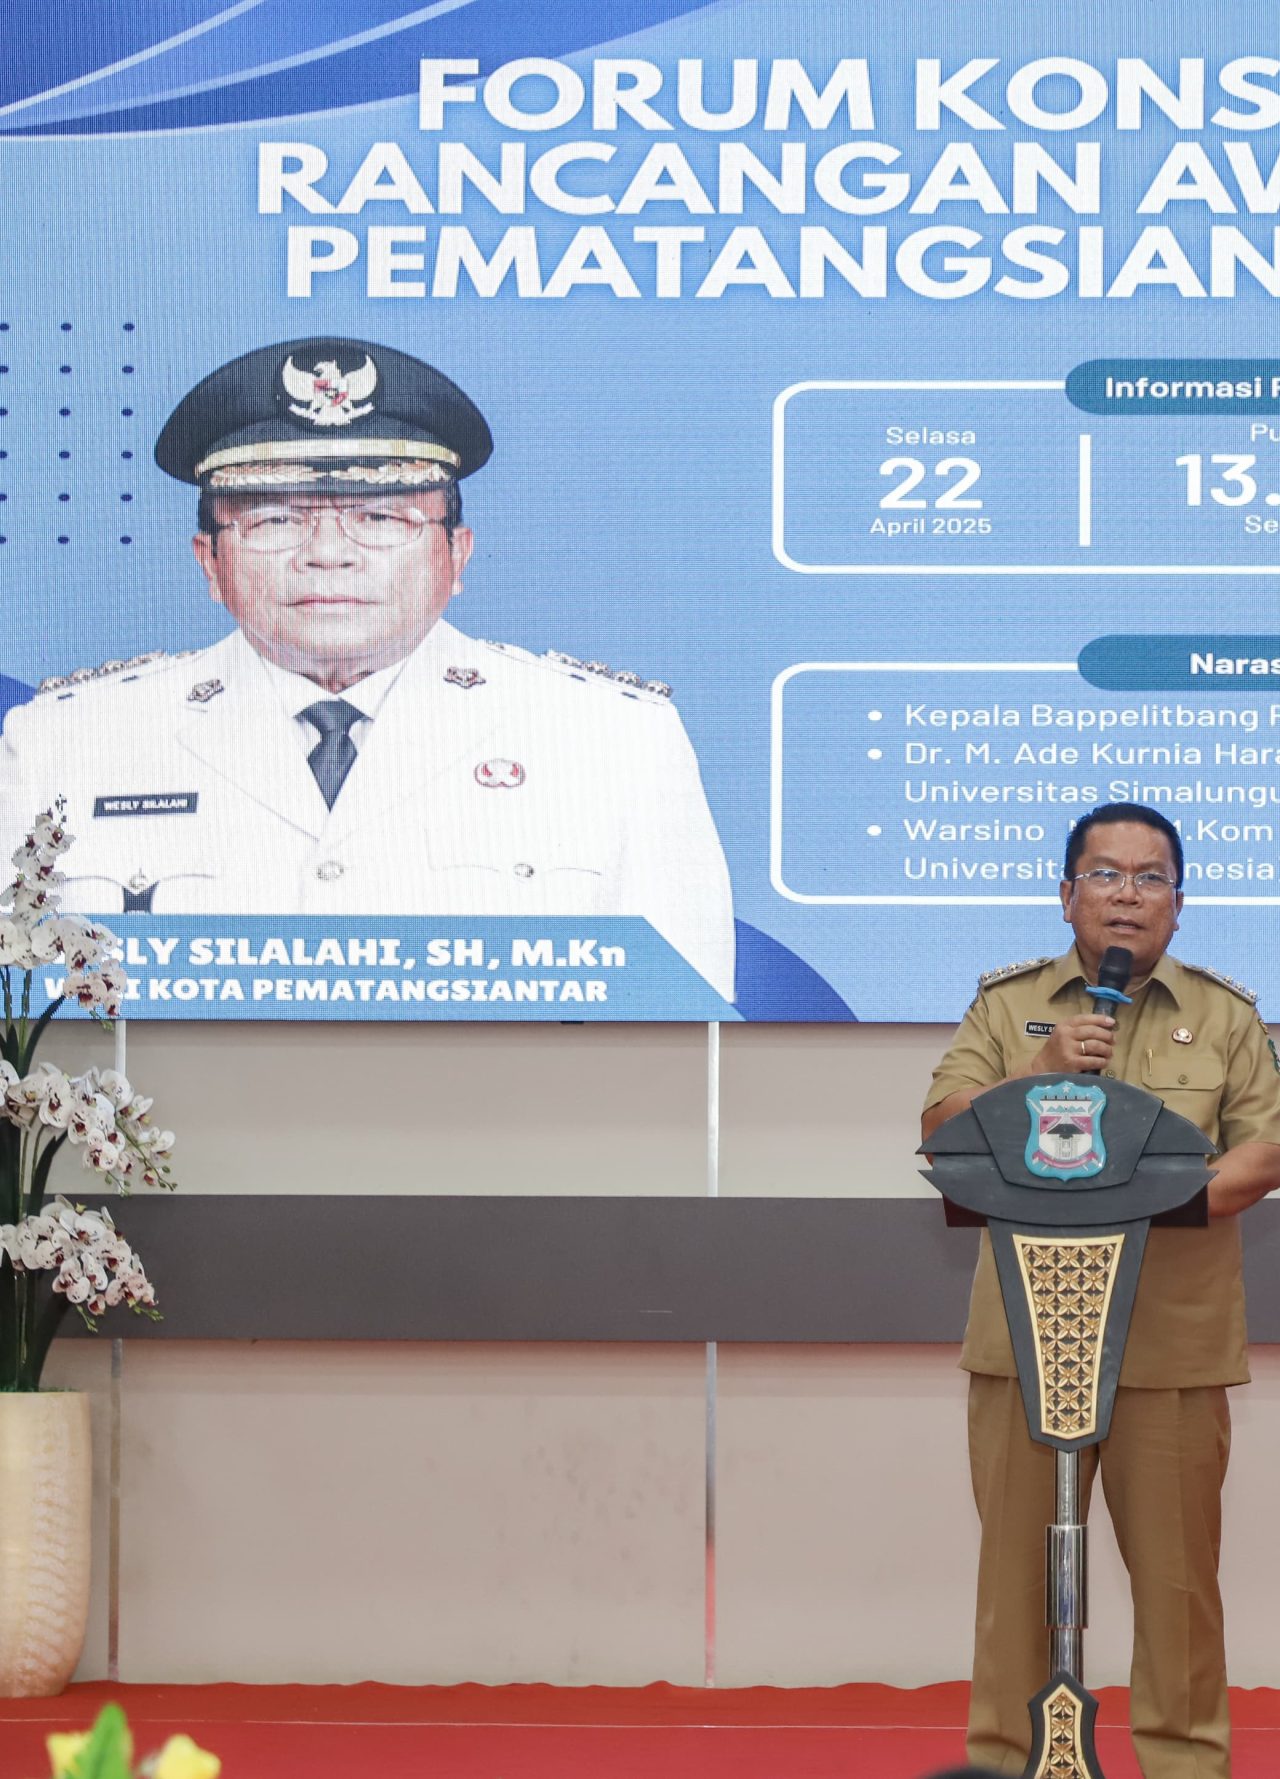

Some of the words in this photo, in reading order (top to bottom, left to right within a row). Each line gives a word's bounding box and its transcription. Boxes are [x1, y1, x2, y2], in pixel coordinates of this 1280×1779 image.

[419, 58, 874, 131] FORUM
[259, 141, 1100, 215] RANCANGAN
[1107, 377, 1261, 397] Informasi
[887, 427, 976, 444] Selasa
[879, 457, 983, 509] 22
[870, 518, 925, 537] April
[933, 518, 991, 534] 2025
[906, 704, 1020, 731] Kepala
[1032, 704, 1258, 732] Bappelitbang
[906, 742, 950, 764] Dr.
[966, 743, 1000, 764] M.
[1014, 743, 1078, 764] Ade
[1092, 743, 1201, 765] Kurnia
[905, 781, 1098, 802] Universitas
[904, 819, 1044, 841] Warsino
[1174, 819, 1273, 841] .Kom
[905, 857, 1064, 880] Universit
[188, 938, 416, 970] SILALAHI,
[426, 938, 500, 970] SH,
[511, 939, 626, 967] M.Kn
[149, 978, 245, 1001] KOTA
[252, 979, 608, 1002] PEMATANGSIANTAR
